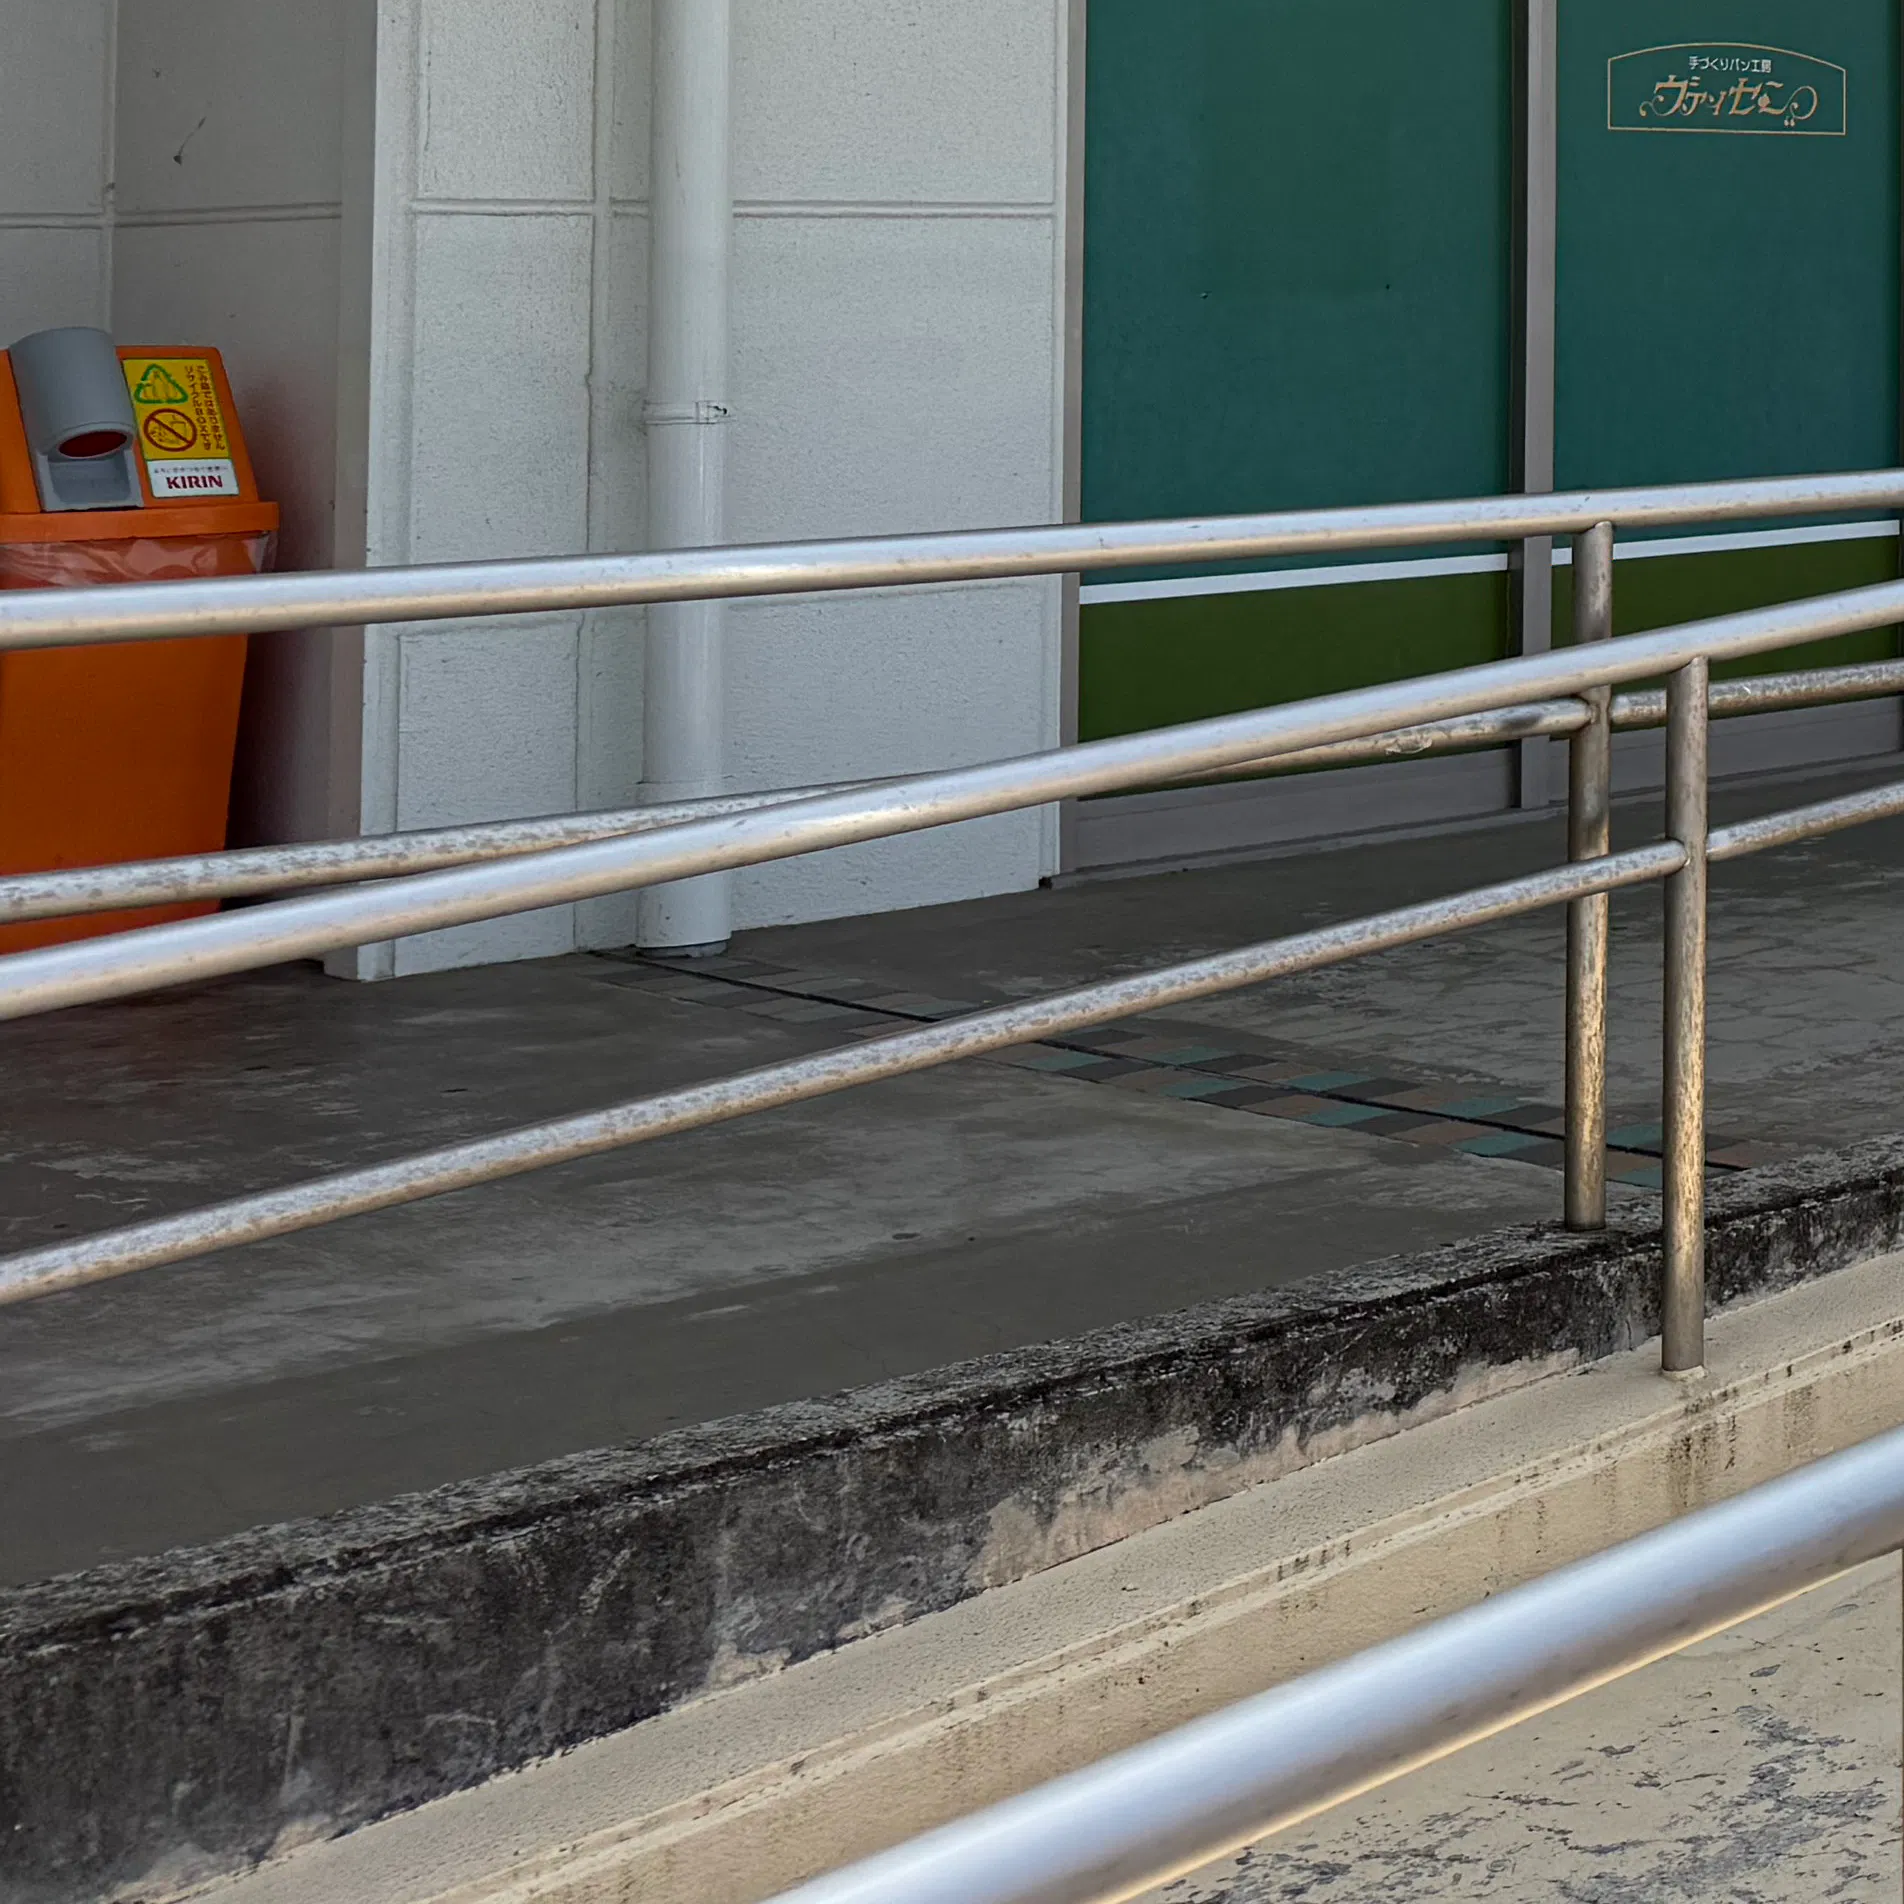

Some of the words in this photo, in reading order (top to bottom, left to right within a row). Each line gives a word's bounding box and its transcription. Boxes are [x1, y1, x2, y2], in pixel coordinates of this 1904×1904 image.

[1688, 55, 1773, 74] 手づくりパン工房
[165, 475, 223, 490] KIRIN
